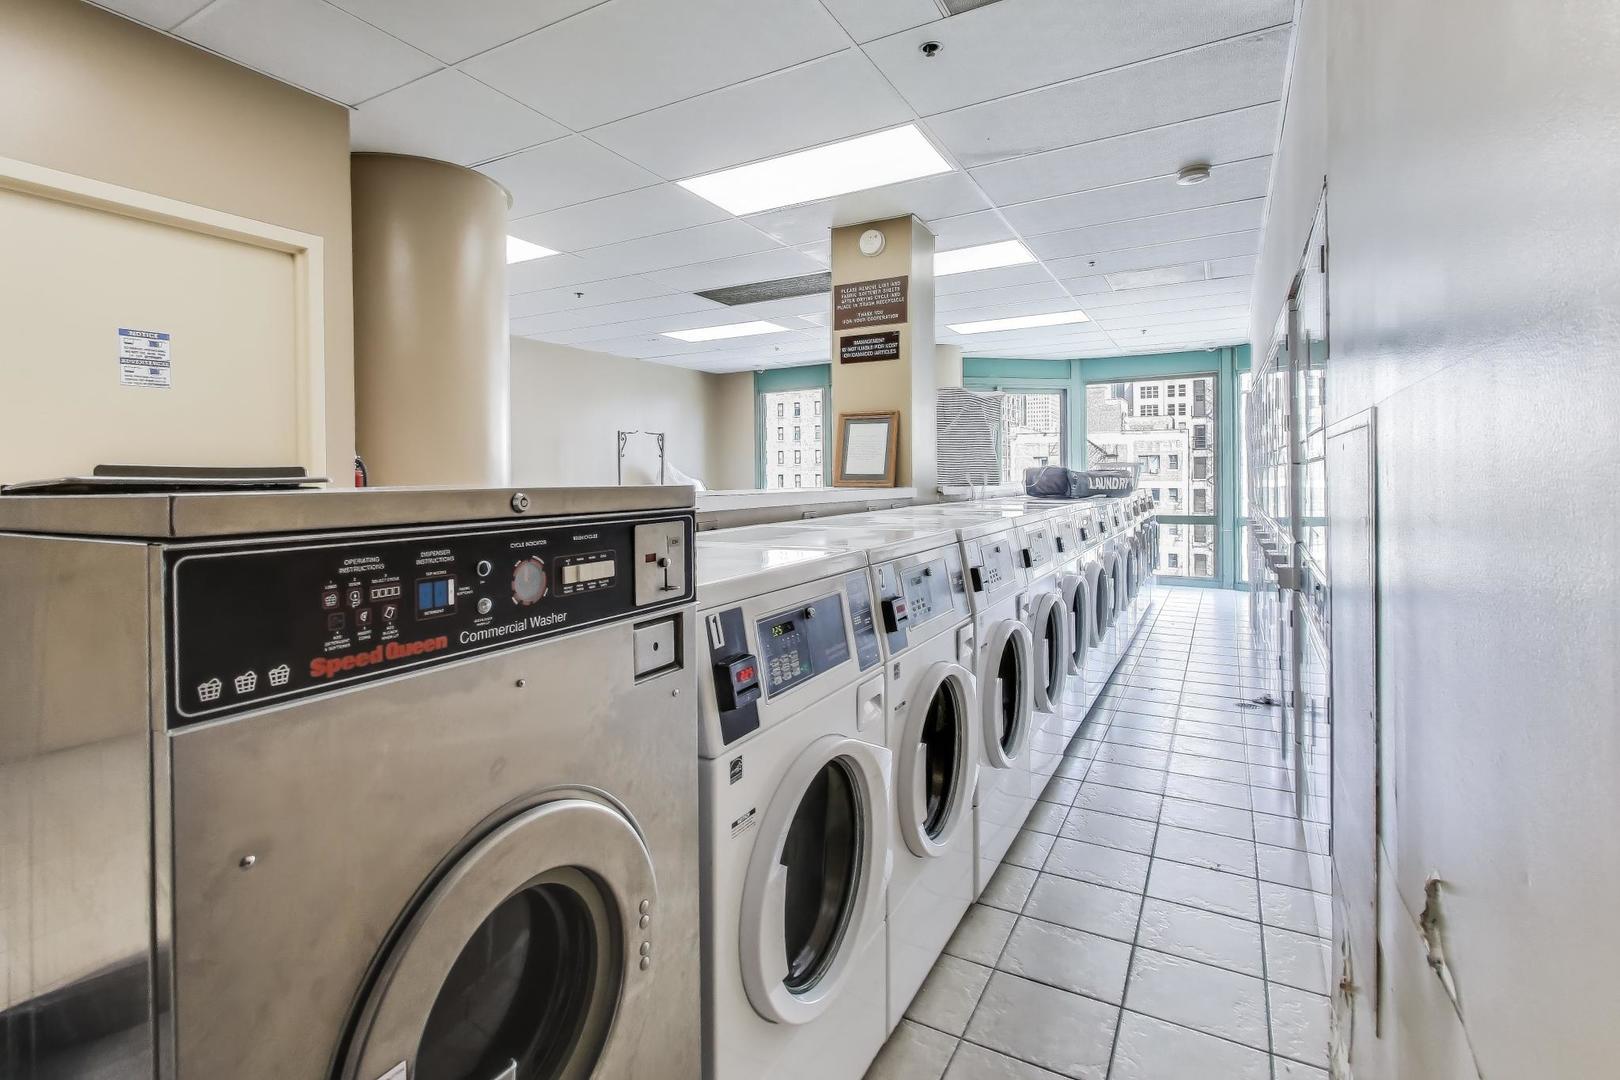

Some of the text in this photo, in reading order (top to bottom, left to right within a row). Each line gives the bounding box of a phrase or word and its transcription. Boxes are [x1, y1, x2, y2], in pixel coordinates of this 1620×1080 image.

[858, 284, 877, 292] REMOVE
[878, 282, 889, 290] LINT
[876, 297, 905, 305] RECEPTACLE
[867, 313, 899, 322] COOPERATION
[128, 330, 160, 339] NOTICE
[853, 337, 885, 345] MANAGEMENT
[874, 348, 897, 356] ARTICLES
[1088, 476, 1129, 490] LAUNDRY
[510, 539, 547, 550] CYCLE INDICATOR
[420, 549, 451, 559] DISPENSER
[344, 556, 380, 567] OPERATING
[416, 555, 455, 566] INSTRUCTIONS
[339, 563, 385, 575] INSTRUCTIONS
[460, 617, 527, 644] Commercial
[530, 611, 568, 630] Washer
[310, 635, 448, 678] Speed Queen
